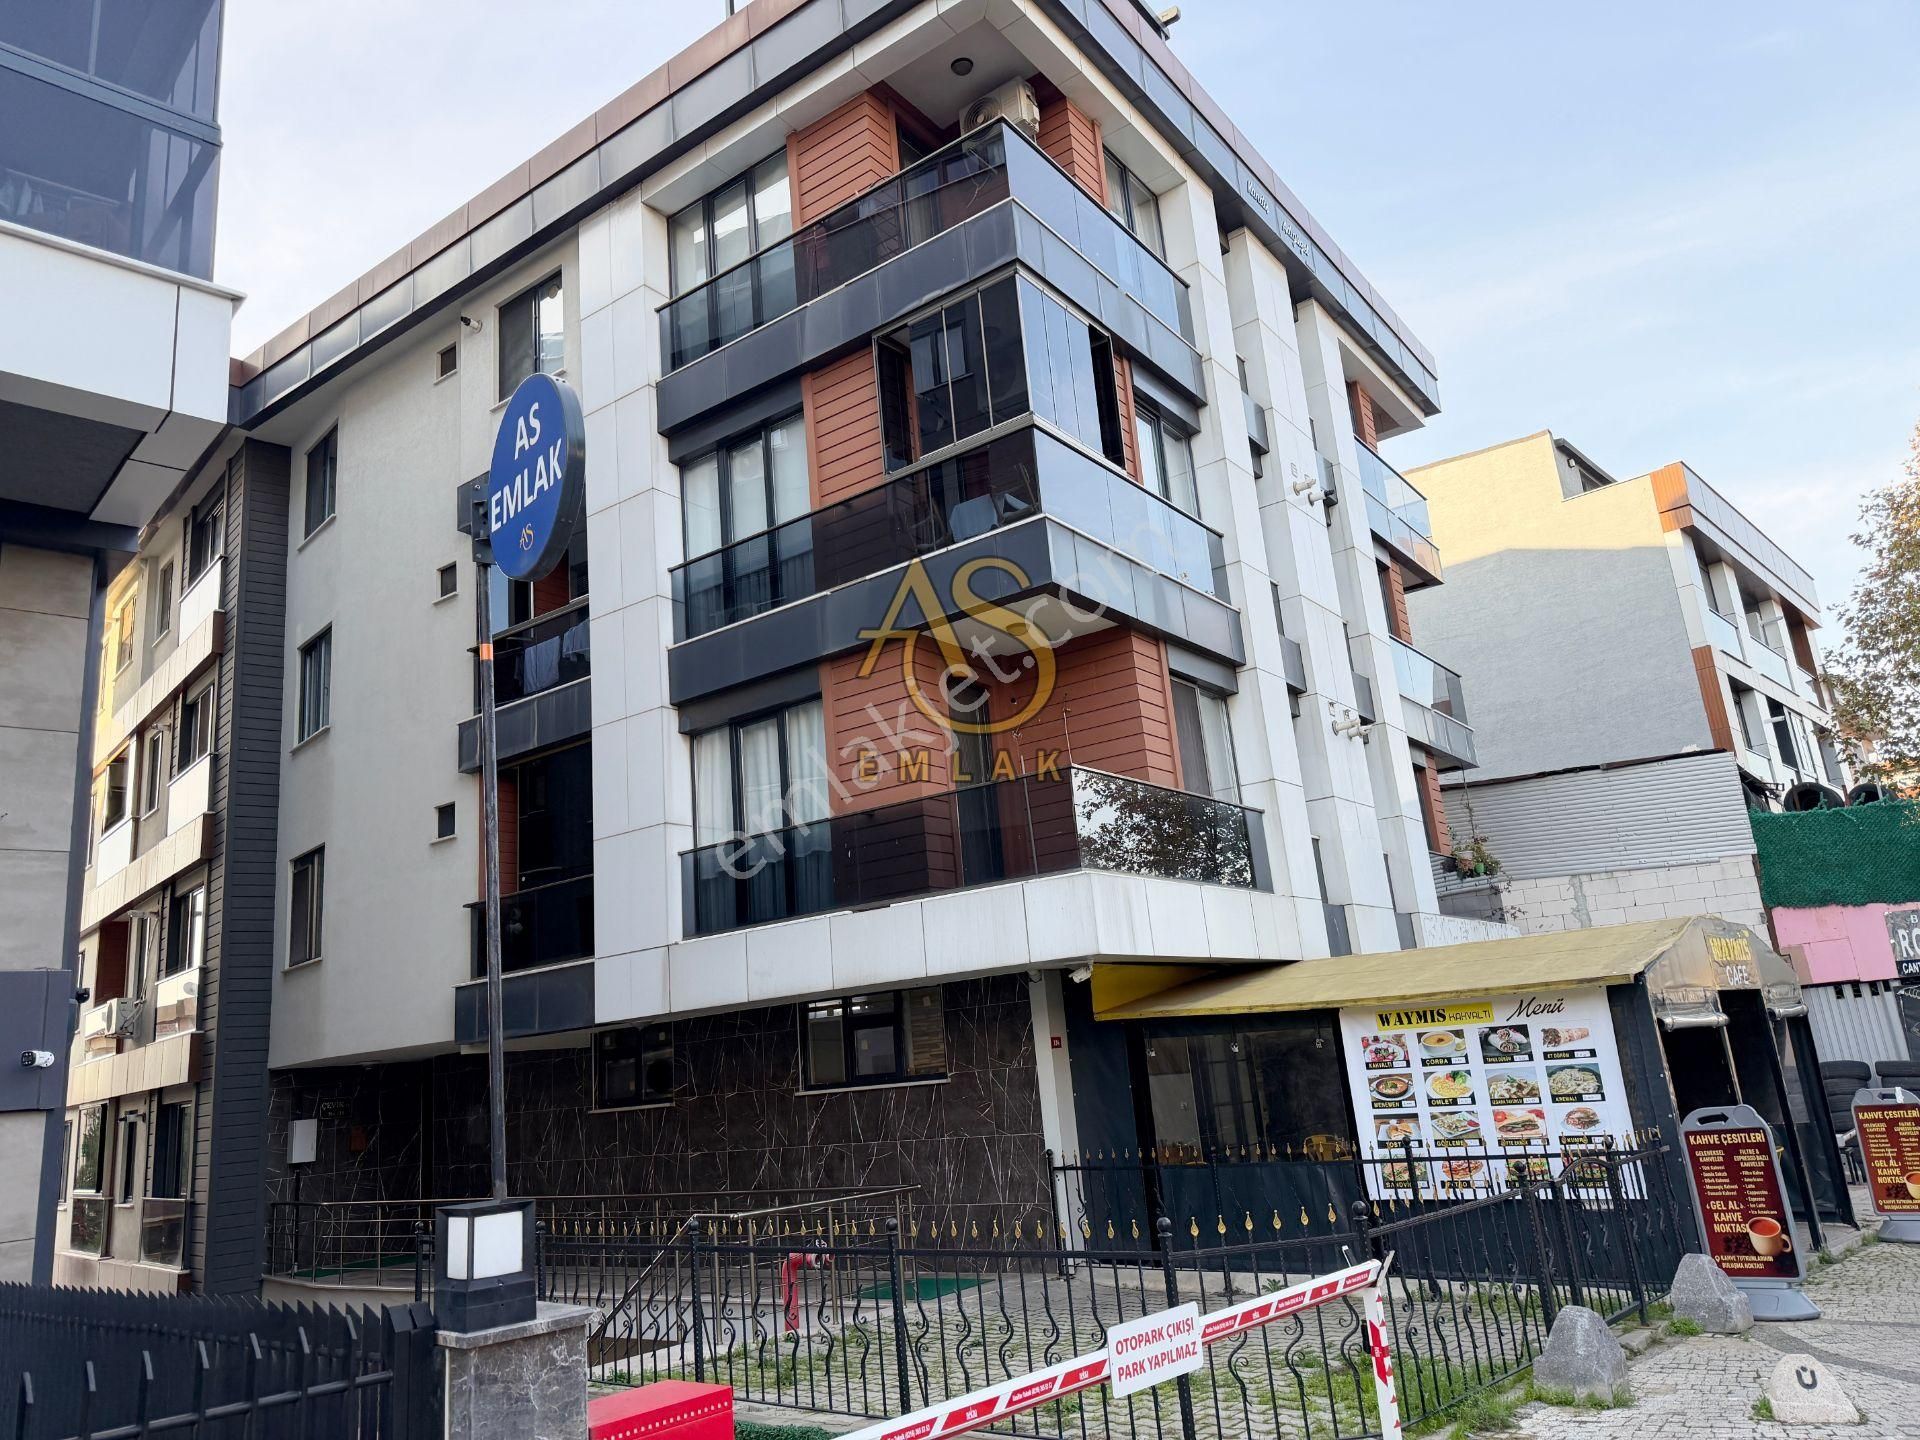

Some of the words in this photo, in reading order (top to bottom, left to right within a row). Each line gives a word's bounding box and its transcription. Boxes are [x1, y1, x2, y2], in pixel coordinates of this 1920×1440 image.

[514, 401, 541, 460] AS
[491, 437, 563, 534] EMLAK
[1726, 965, 1749, 986] CAFE
[1378, 1008, 1447, 1027] WAYMIS
[1506, 997, 1565, 1021] Menü
[1426, 1058, 1448, 1067] ÇORBA
[1858, 1111, 1882, 1120] KAHVE
[1689, 1134, 1721, 1146] KAHVE
[1877, 1168, 1901, 1176] KAHVE
[1710, 1200, 1727, 1210] GEL
[1728, 1200, 1740, 1210] AL
[1713, 1212, 1743, 1222] KAHVE
[1115, 1326, 1165, 1356] OTOPARK
[1166, 1316, 1195, 1342] ÇIKIŞI
[1117, 1359, 1147, 1383] PARK
[1147, 1340, 1198, 1371] YAPILMAZ
